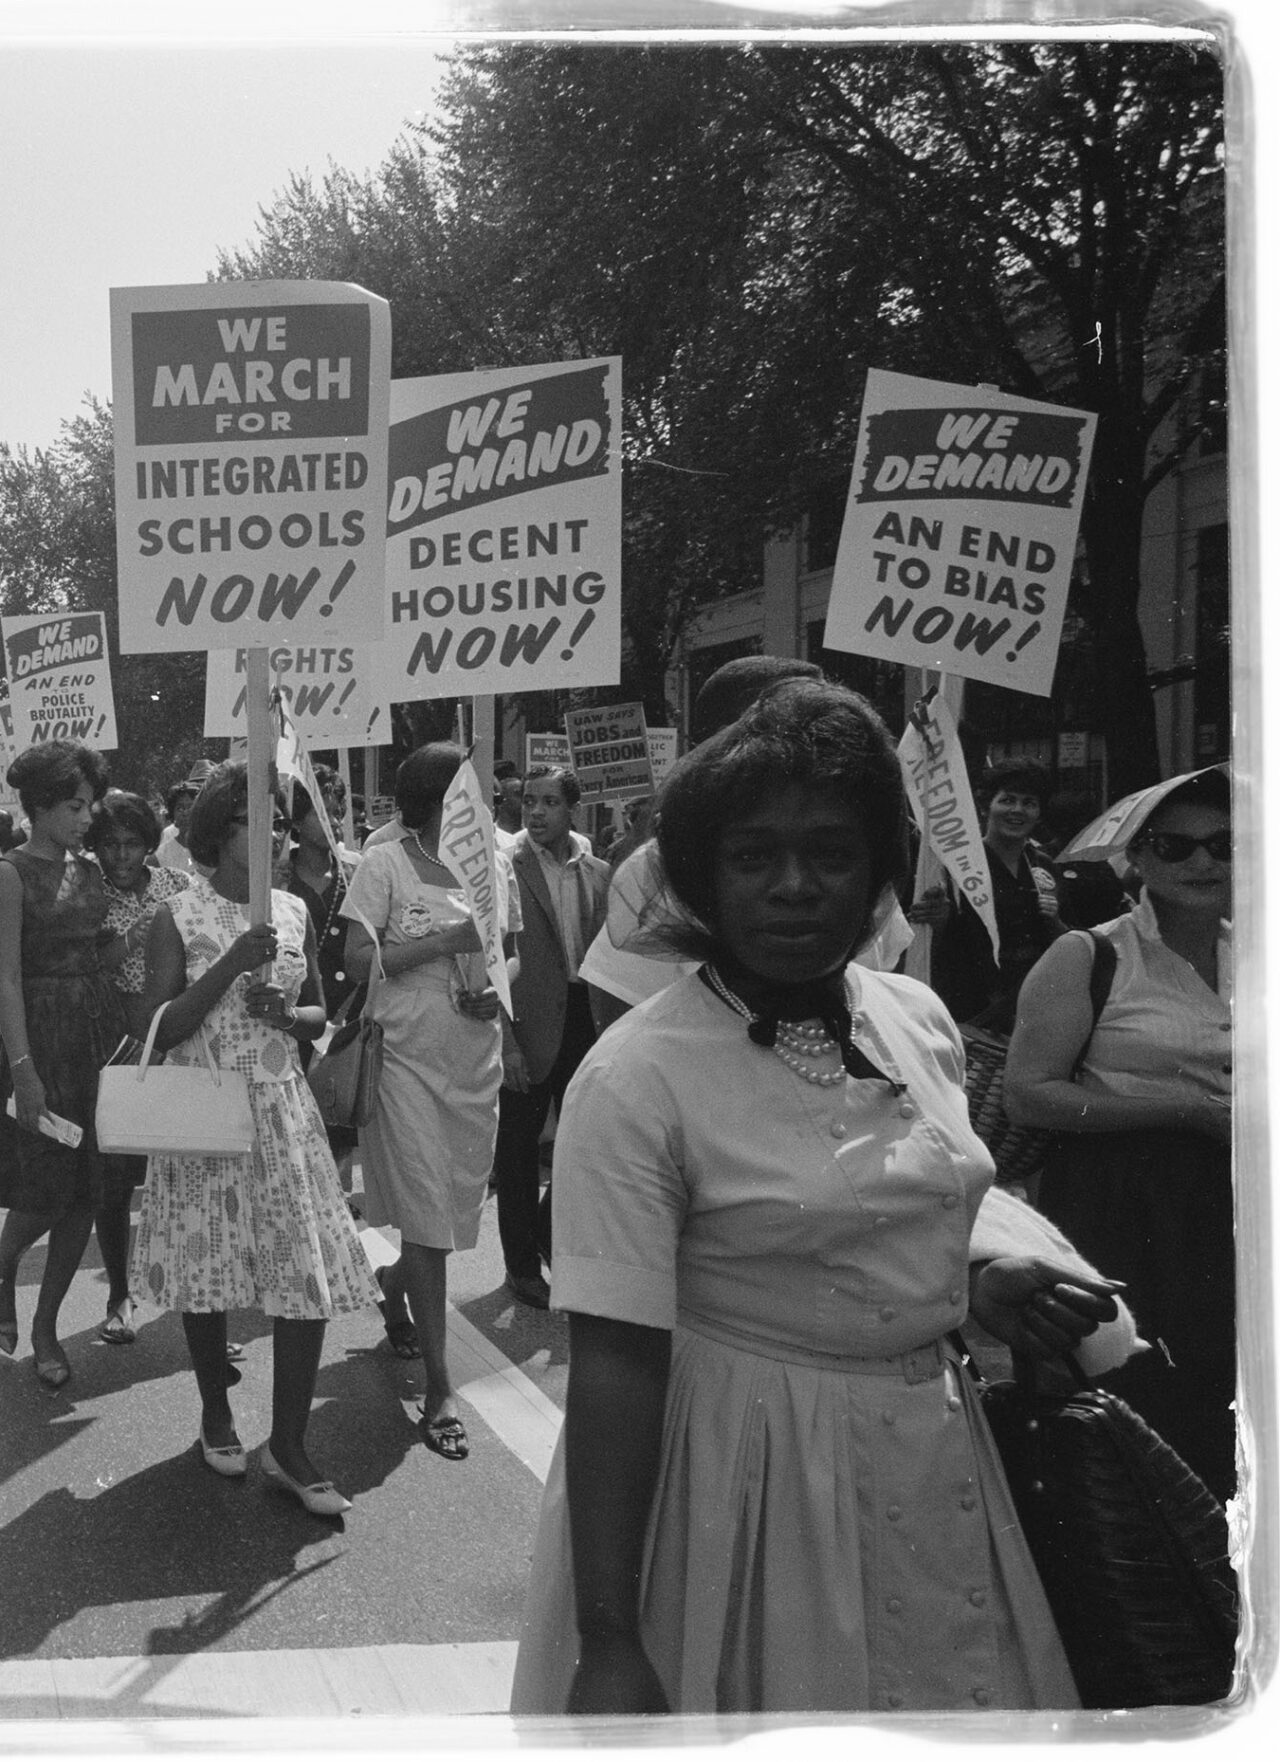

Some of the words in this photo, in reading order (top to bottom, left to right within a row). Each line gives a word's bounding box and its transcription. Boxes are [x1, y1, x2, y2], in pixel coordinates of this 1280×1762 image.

[217, 316, 287, 353] WE
[151, 357, 352, 407] MARCH
[215, 411, 292, 434] FOR
[446, 389, 533, 454] WE
[936, 412, 1020, 450] WE
[135, 451, 368, 500] INTEGRATED
[387, 418, 602, 523] DEMAND
[872, 452, 1071, 494] DEMAND
[137, 509, 365, 557] SCHOOLS
[409, 518, 589, 570] DECENT
[872, 510, 943, 551] AN
[959, 524, 1057, 574] END
[155, 558, 357, 627] NOW!
[391, 571, 607, 623] HOUSING
[873, 550, 931, 590] TO
[944, 564, 1047, 616] BIAS
[38, 620, 73, 647] WE
[406, 607, 596, 677] NOW!
[864, 594, 1042, 663] NOW!
[16, 633, 99, 676] DEMAND
[235, 647, 354, 674] RGHTS
[24, 676, 54, 691] AN
[58, 674, 96, 688] END
[41, 693, 86, 708] POLICE
[232, 678, 357, 718] W!
[30, 705, 95, 722] BRUTALITY
[31, 713, 107, 744] NOW!
[573, 714, 603, 726] UAW
[607, 708, 636, 721] SAYS
[532, 747, 569, 757] MARCH
[573, 724, 620, 746] JOBS
[622, 725, 642, 739] and
[574, 742, 647, 767] FREEDOM
[440, 788, 494, 920] FREEDOM
[956, 855, 971, 873] IN
[962, 870, 989, 908] '63
